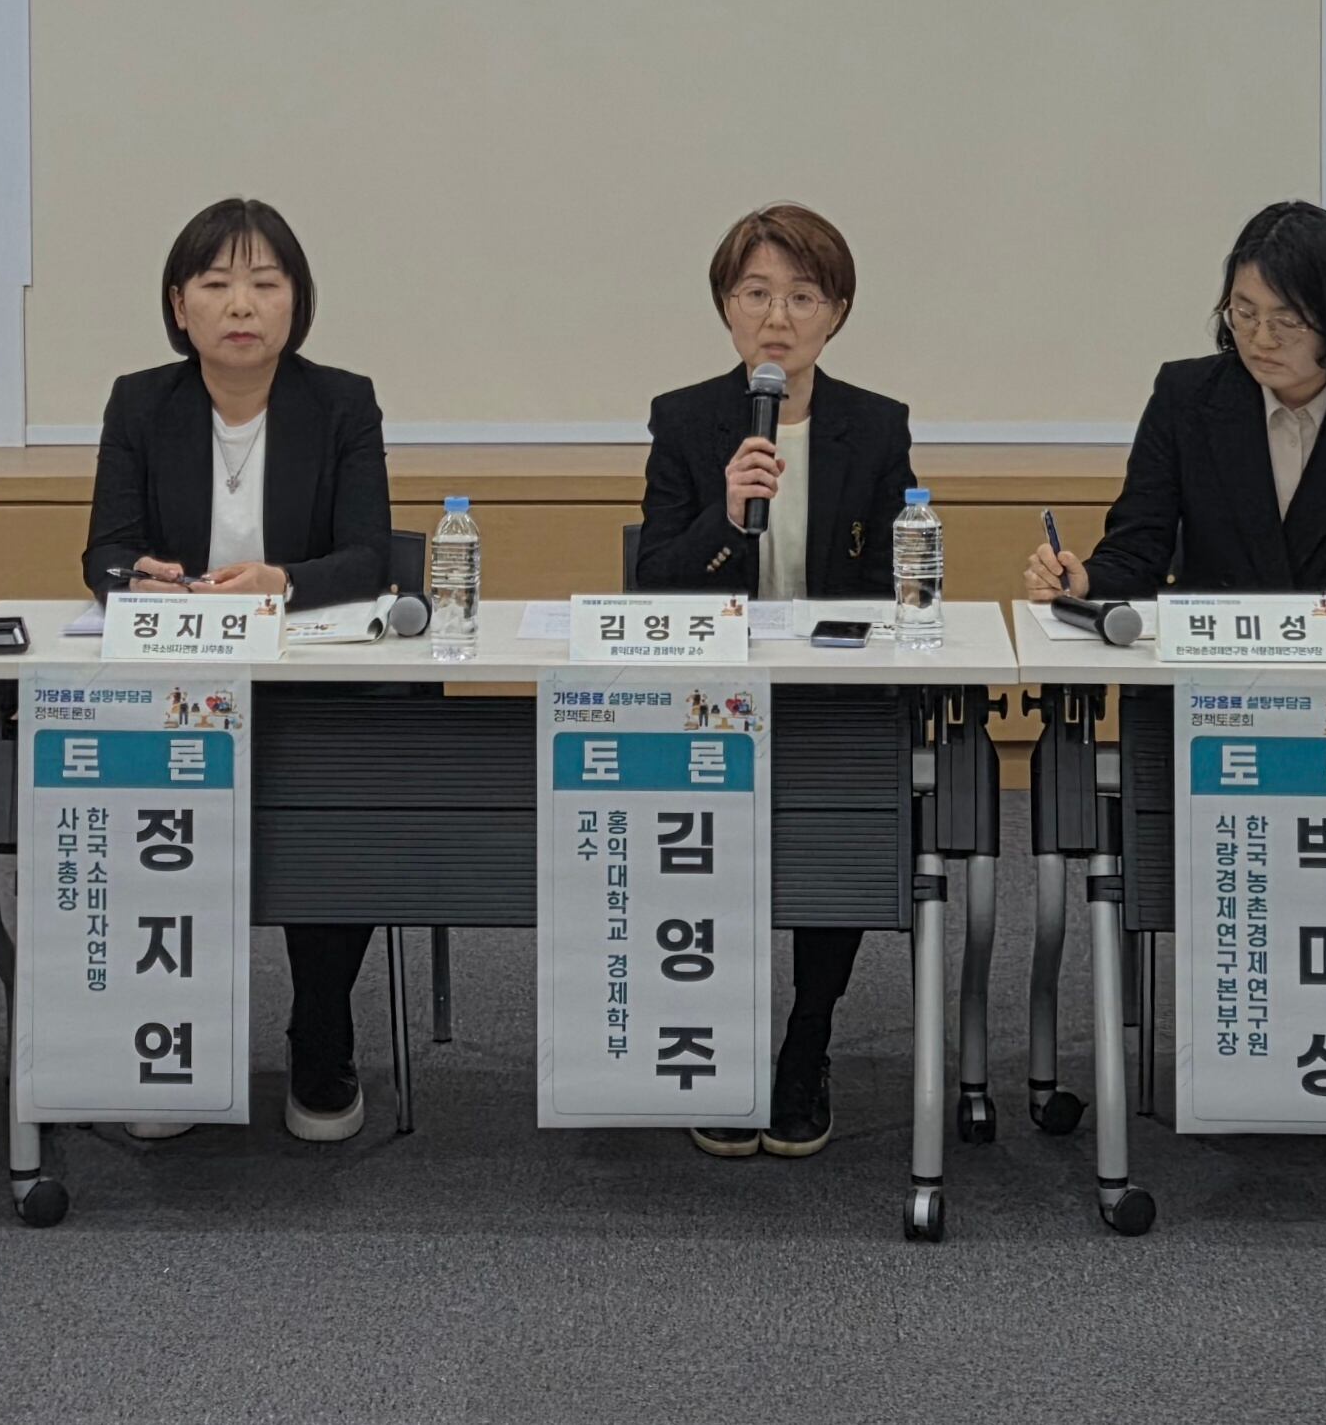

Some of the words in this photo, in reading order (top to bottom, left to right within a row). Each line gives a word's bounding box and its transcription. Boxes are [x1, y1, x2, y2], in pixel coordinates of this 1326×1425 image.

[34, 689, 85, 703] 가당음료
[88, 689, 153, 704] 설탕부담금
[34, 706, 96, 721] 정책토론회
[553, 691, 605, 705] 가당음료
[608, 692, 672, 706] 설탕부담금
[553, 709, 615, 724] 정책토론회
[1190, 695, 1243, 710] 가당음료
[1246, 696, 1312, 710] 설탕부담금
[1191, 712, 1254, 727] 정책토론회
[57, 807, 80, 911] 사무총장
[577, 810, 598, 861] 교수
[86, 806, 110, 992] 한국소비자연맹
[607, 810, 630, 941] 홍익대학교
[1215, 815, 1240, 1056] 식량경제연구본부장
[1246, 814, 1269, 1057] 한국농촌경제연구원
[606, 954, 630, 1059] 경제학부
